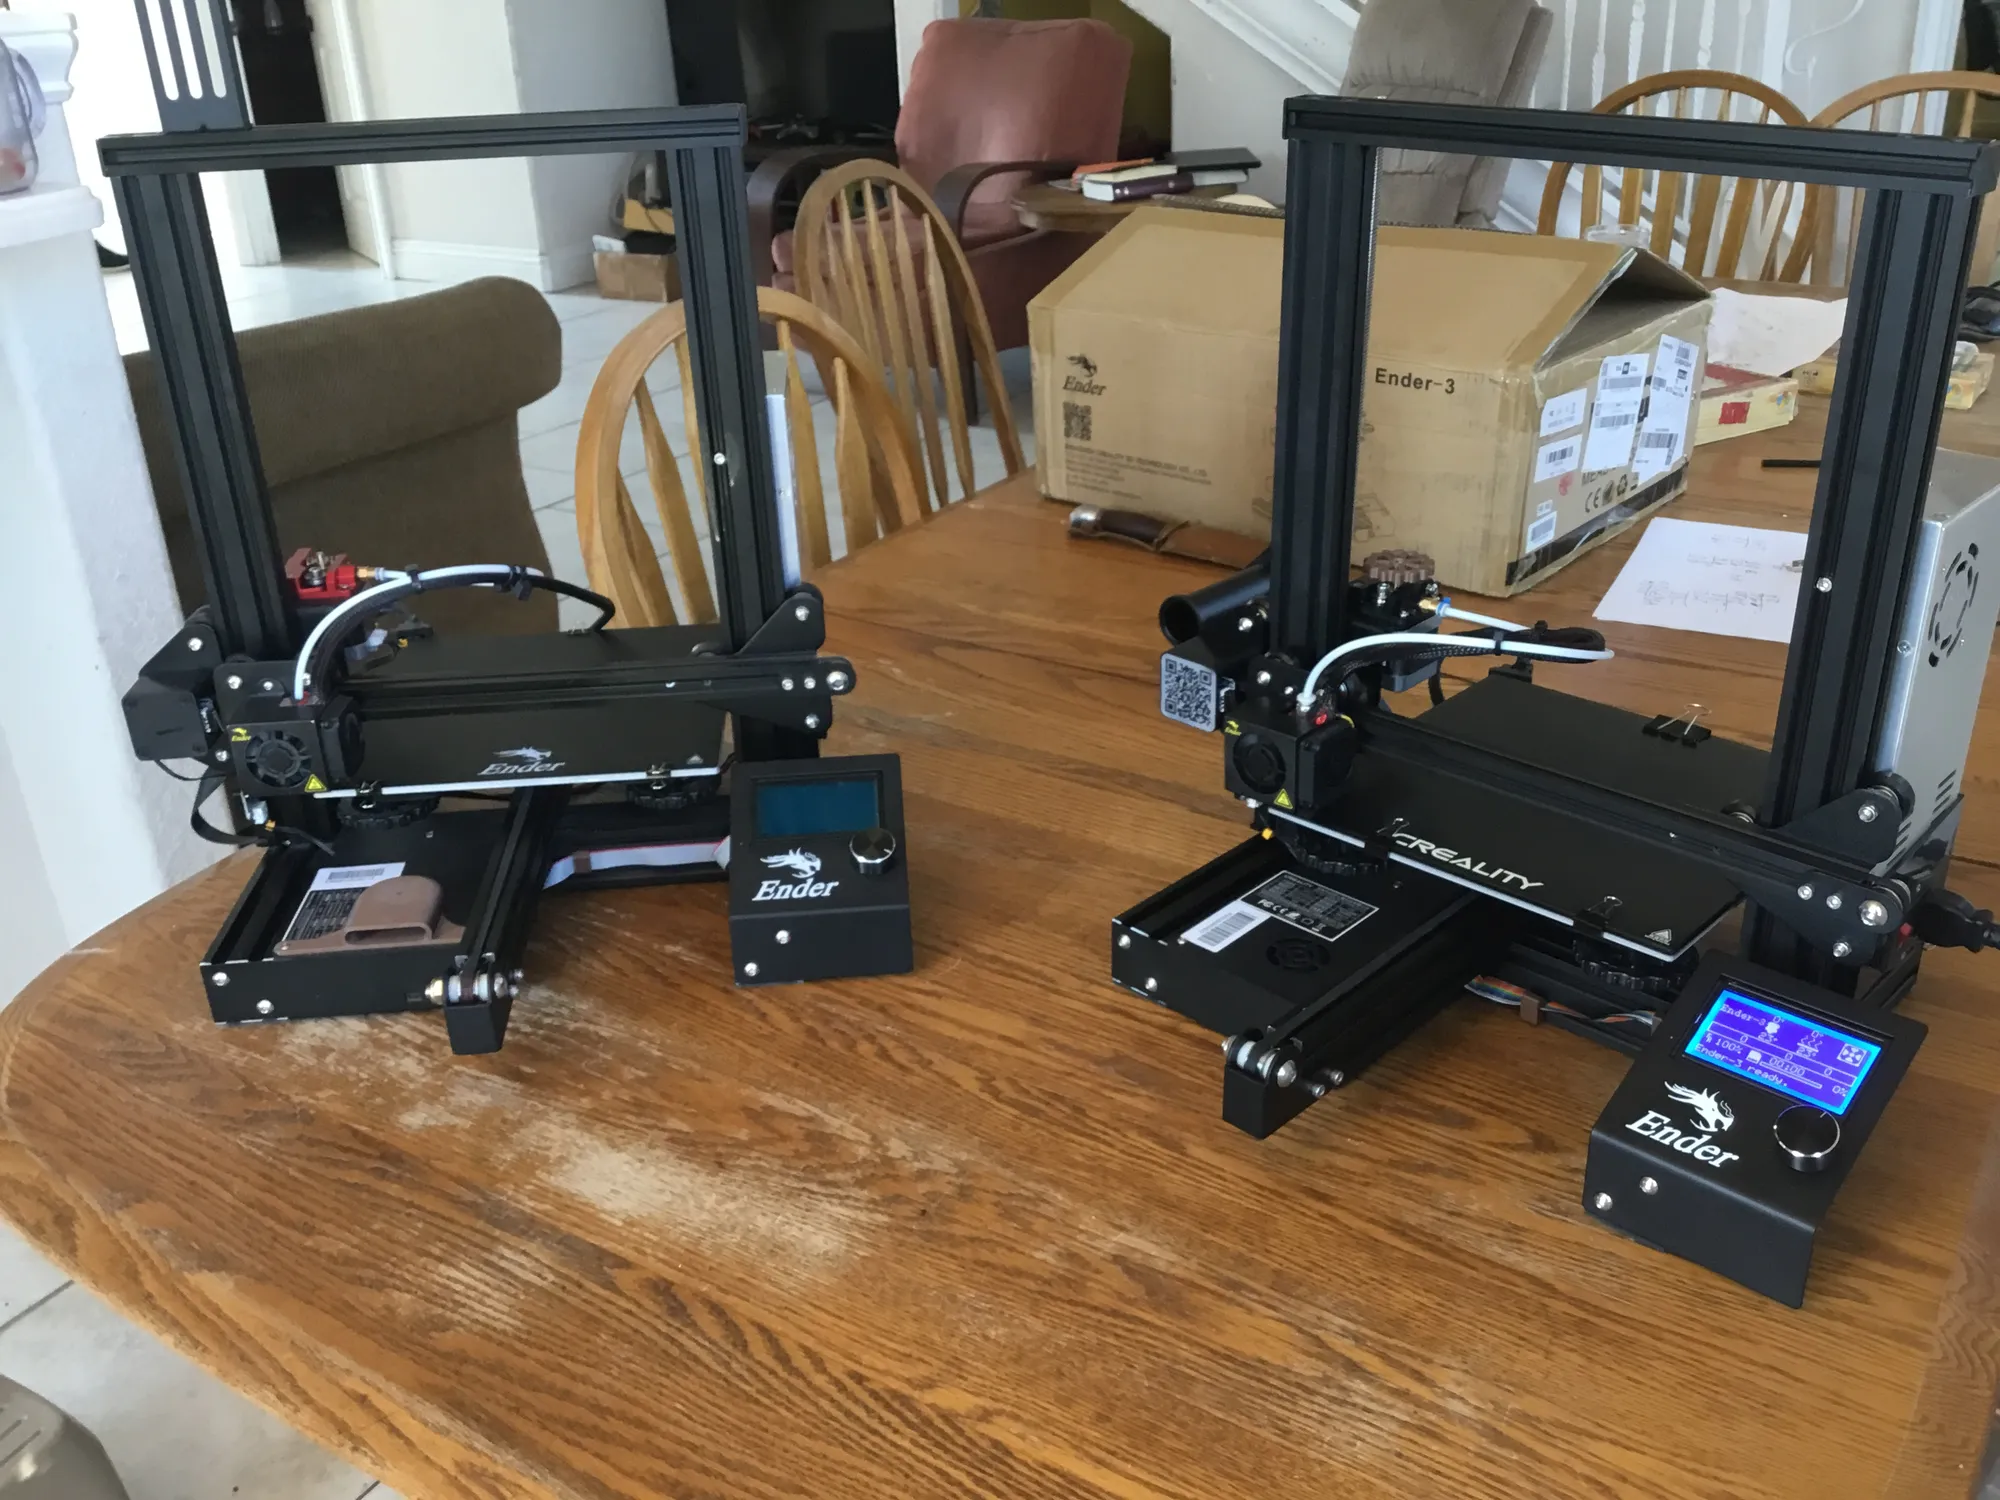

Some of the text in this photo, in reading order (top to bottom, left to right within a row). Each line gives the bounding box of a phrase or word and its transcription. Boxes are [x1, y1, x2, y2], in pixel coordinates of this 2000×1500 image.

[1062, 375, 1107, 396] Ender
[1374, 367, 1456, 395] Ender-3
[476, 761, 566, 776] Ender
[1391, 832, 1545, 890] CREALITY
[751, 877, 840, 901] Ender
[1720, 1003, 1767, 1026] Ender-3
[1693, 1042, 1744, 1068] Ender-3
[1715, 1038, 1744, 1055] 100%
[1768, 1056, 1806, 1077] 00:00
[1831, 1084, 1849, 1098] 0%
[1624, 1109, 1740, 1169] Ender
